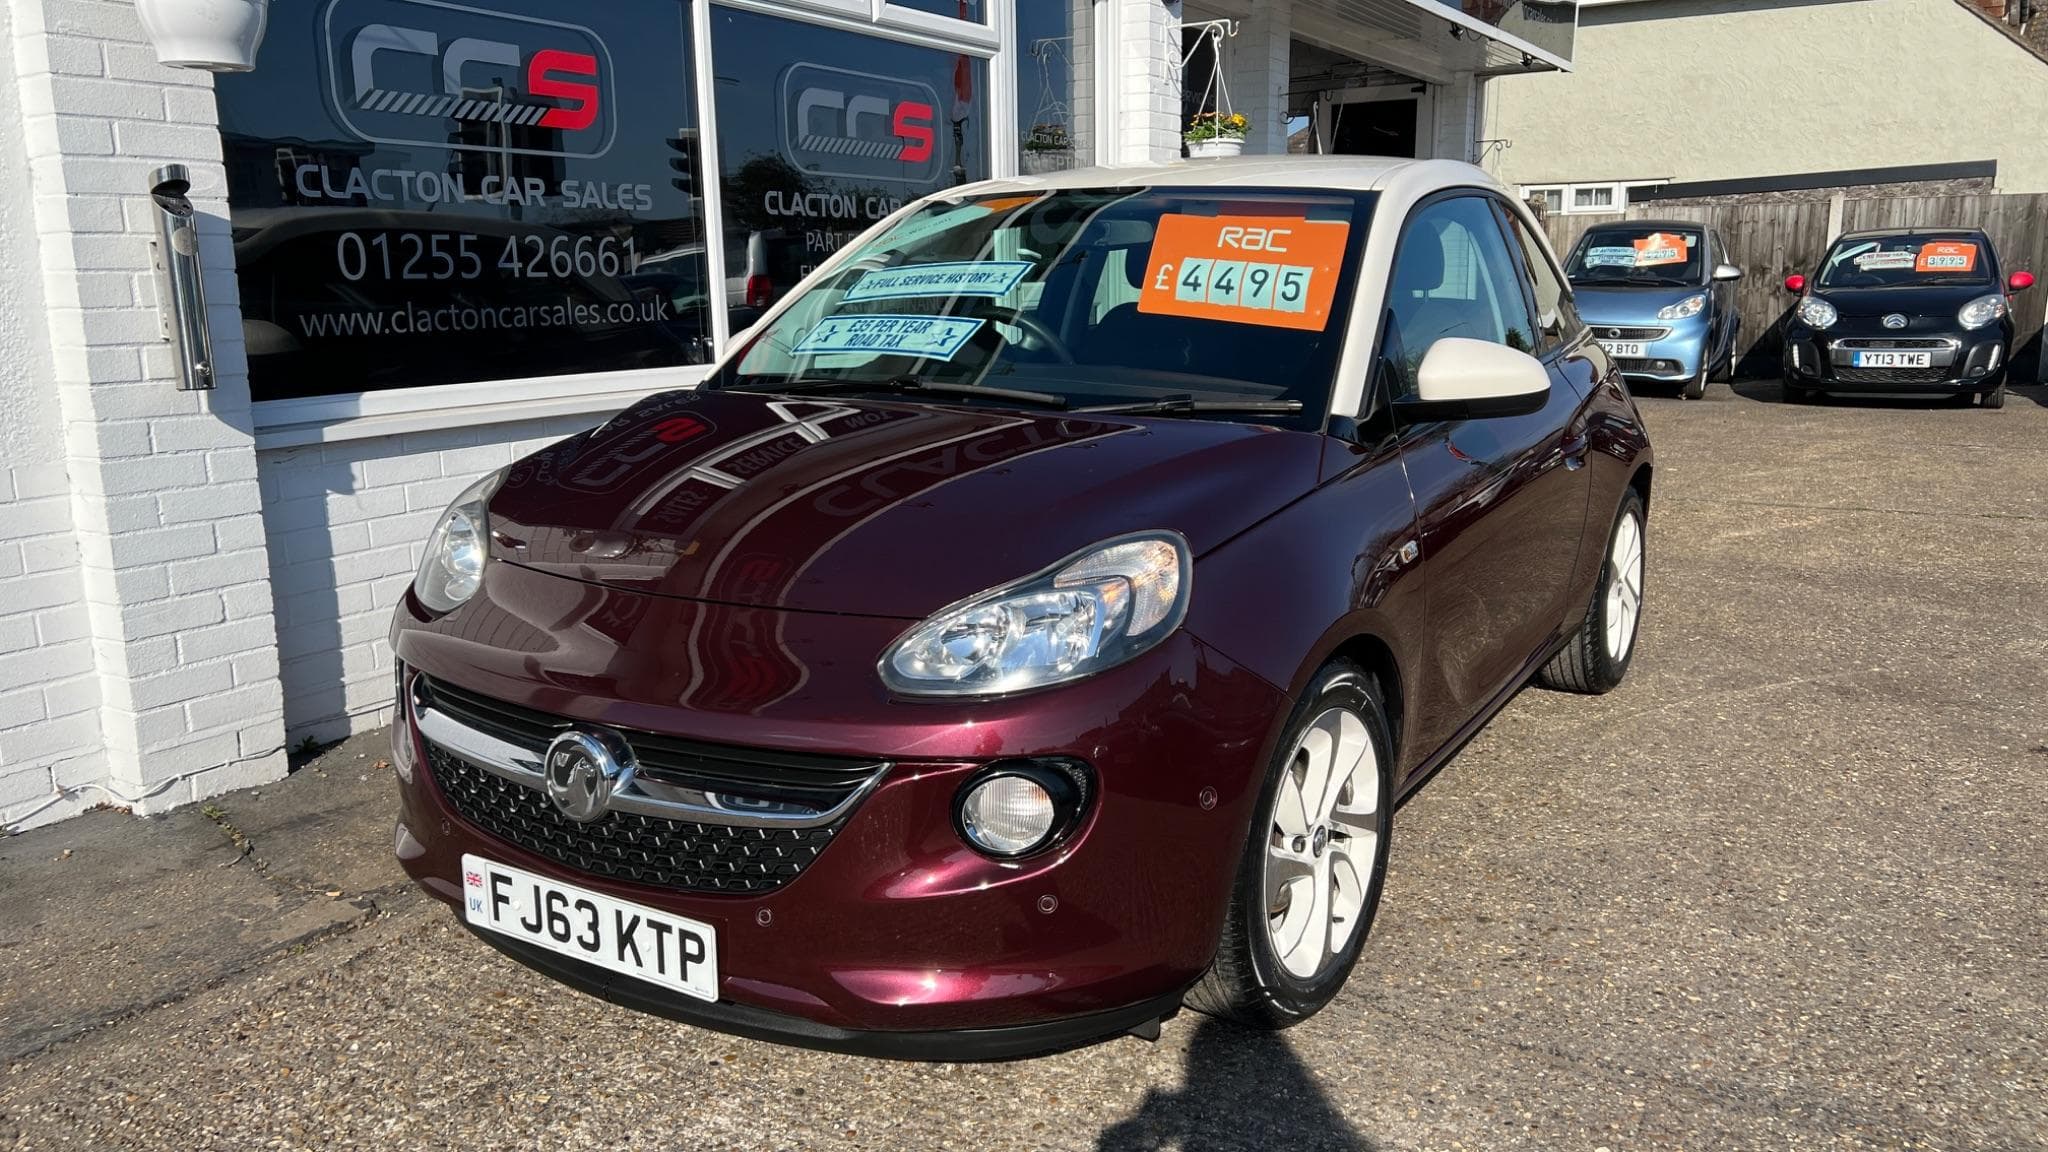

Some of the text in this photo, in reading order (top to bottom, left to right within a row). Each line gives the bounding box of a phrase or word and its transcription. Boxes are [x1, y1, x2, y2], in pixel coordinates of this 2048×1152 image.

[352, 24, 598, 130] CCS
[798, 88, 934, 162] CCS
[296, 164, 652, 211] CLACTON CAR SALES
[765, 190, 857, 219] CLACTON
[806, 232, 842, 252] PART
[337, 232, 639, 281] 01255 426661
[873, 271, 993, 290] FULL SERVICE HISTORY
[299, 295, 669, 337] www.clactoncarsales.co.uk
[846, 319, 933, 334] £35 PER YEAR
[844, 334, 908, 348] ROAD TAX
[1616, 344, 1639, 354] BTO
[1865, 353, 1925, 365] YT13 TWE
[468, 897, 483, 914] UK
[490, 871, 706, 983] FJ63 KTP
